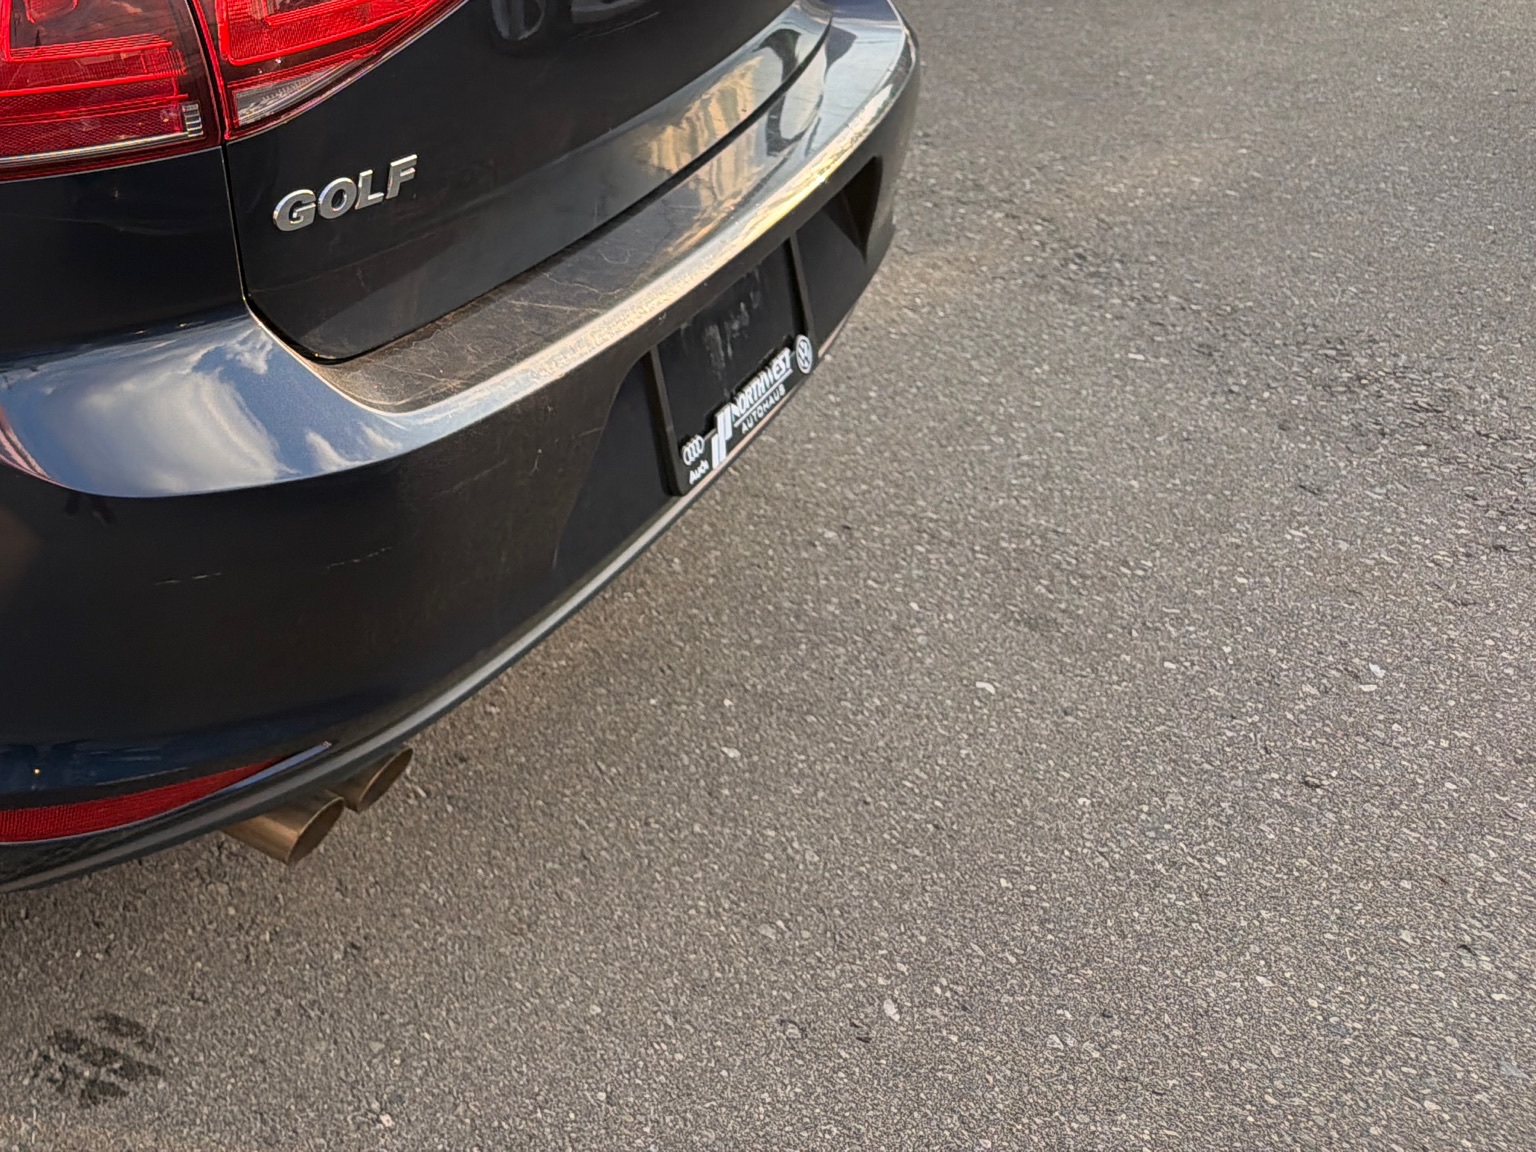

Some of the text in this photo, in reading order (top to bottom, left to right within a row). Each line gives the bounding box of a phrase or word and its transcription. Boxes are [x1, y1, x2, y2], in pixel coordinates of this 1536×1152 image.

[272, 153, 419, 232] GOLF
[729, 347, 792, 422] NORTHWEST
[740, 384, 787, 434] AUTOHAUS
[689, 459, 710, 485] Audi
